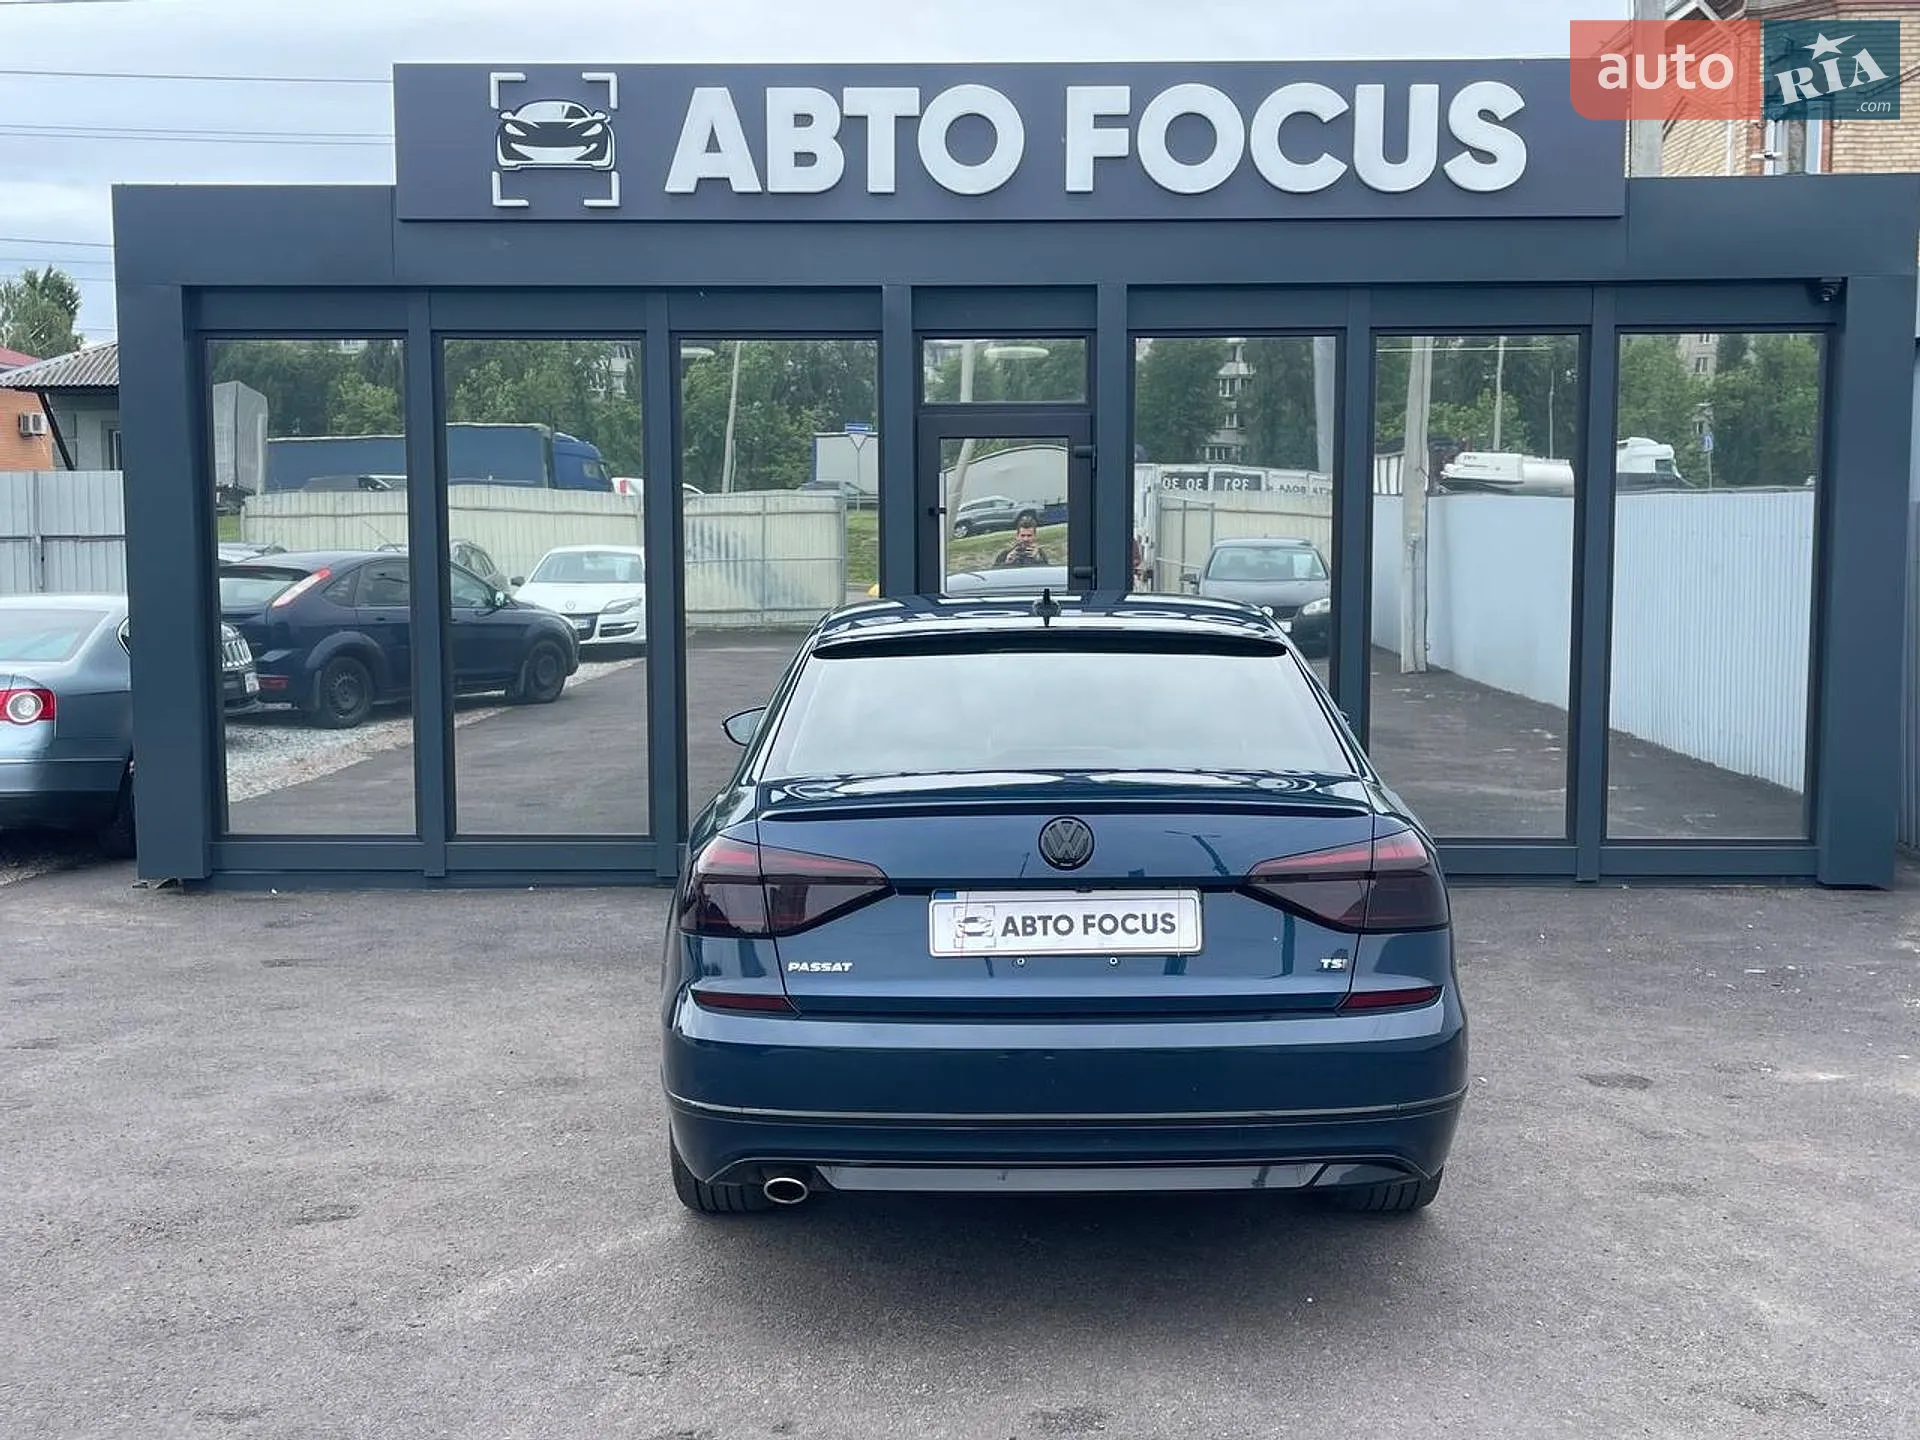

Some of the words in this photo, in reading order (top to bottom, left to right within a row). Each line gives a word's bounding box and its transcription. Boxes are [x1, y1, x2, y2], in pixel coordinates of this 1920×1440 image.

[664, 84, 1026, 196] АВТО
[1065, 80, 1528, 194] FOCUS
[1001, 914, 1075, 937] АВТО
[1082, 912, 1177, 936] FOCUS
[787, 962, 853, 972] PASSAT
